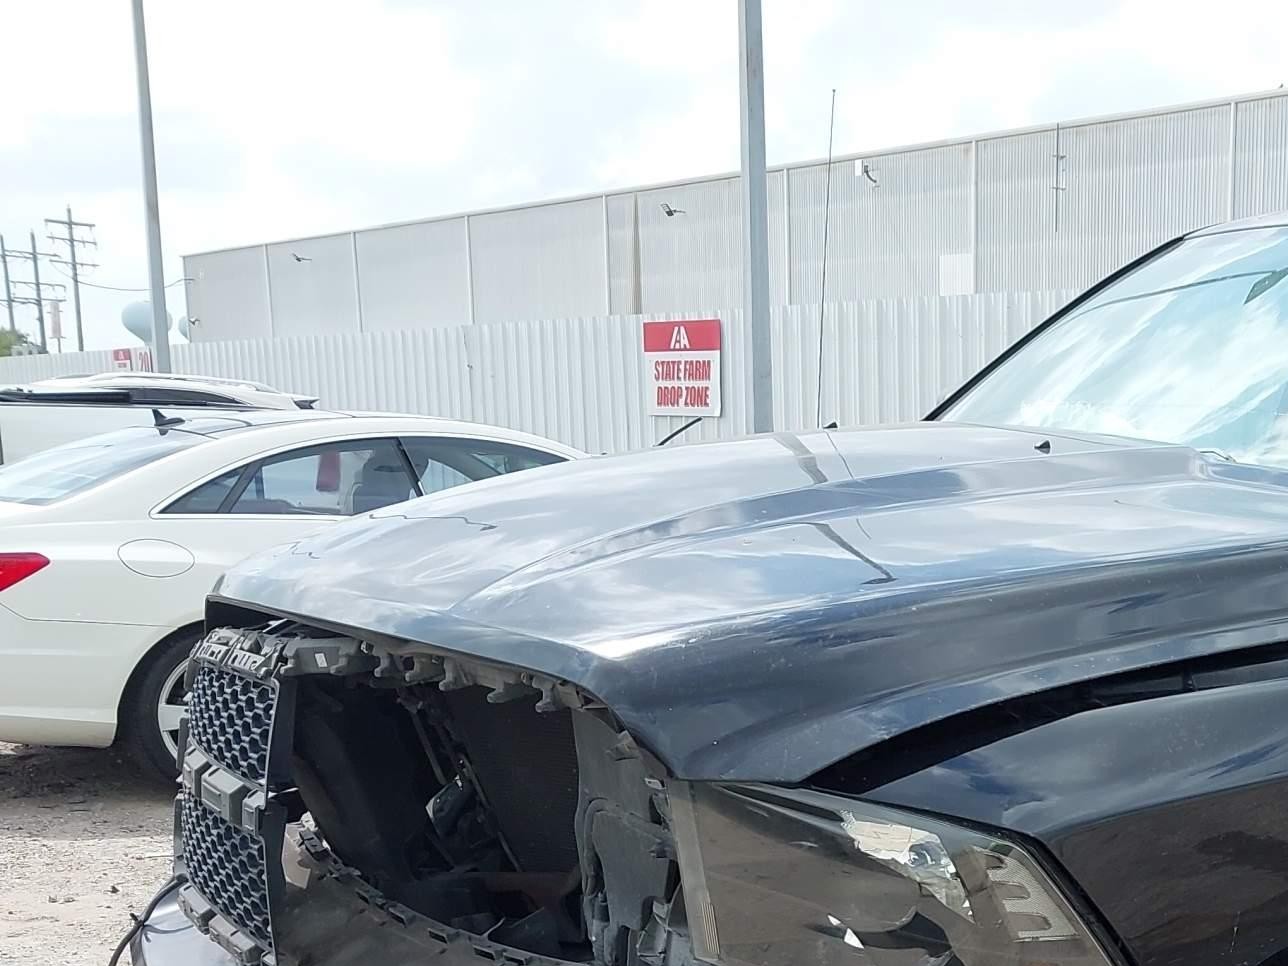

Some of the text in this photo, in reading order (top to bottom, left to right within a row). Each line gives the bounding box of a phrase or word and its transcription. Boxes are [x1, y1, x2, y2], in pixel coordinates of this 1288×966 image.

[654, 359, 711, 381] STATE FARM
[656, 386, 710, 407] DROP ZONE
